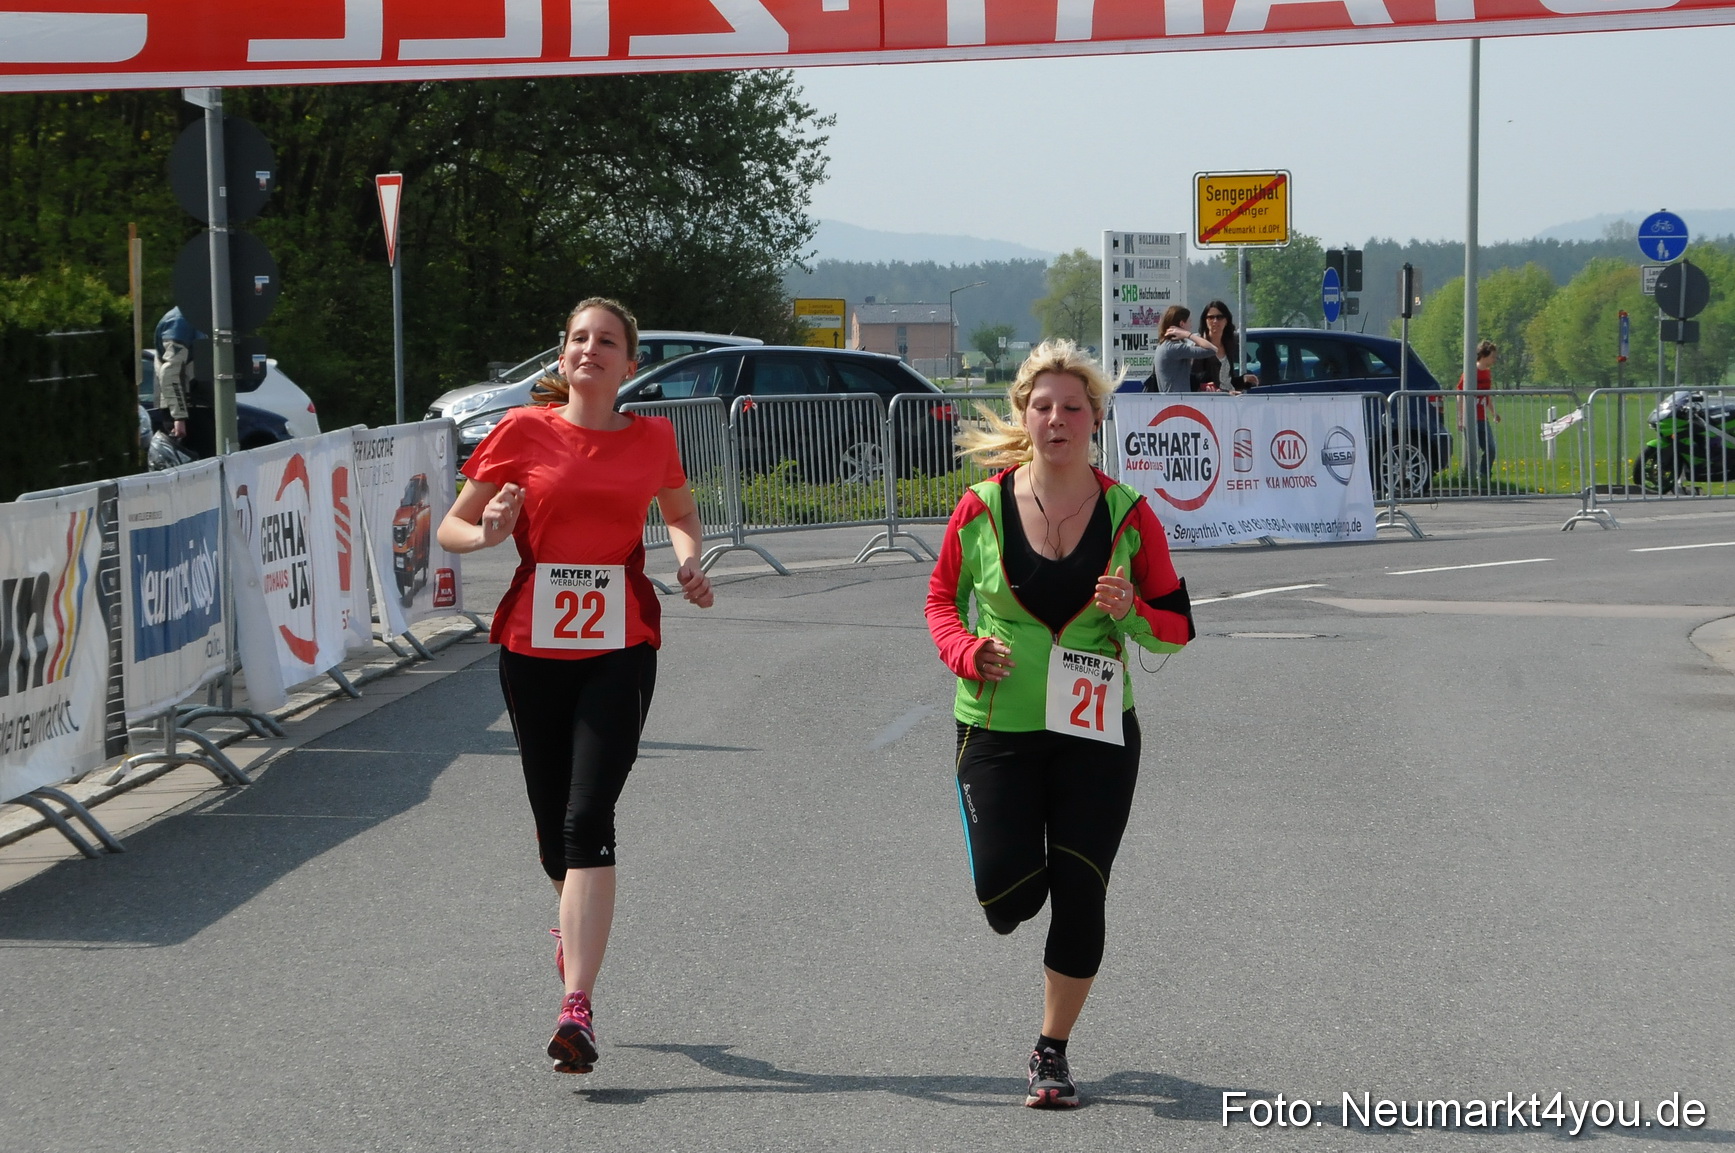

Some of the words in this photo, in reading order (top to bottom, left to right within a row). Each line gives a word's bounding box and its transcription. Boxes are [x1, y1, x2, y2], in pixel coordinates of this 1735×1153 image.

[1206, 184, 1279, 205] Sengenthal
[1216, 208, 1232, 216] am
[1237, 206, 1269, 218] Anger
[1224, 226, 1256, 234] Neumarkt
[1122, 284, 1138, 302] SHB
[1121, 333, 1148, 350] THULE
[1125, 431, 1200, 456] GERHART
[1277, 440, 1301, 460] KIA
[1163, 457, 1211, 481] JÄNIG
[1227, 479, 1259, 491] SEAT
[1265, 476, 1280, 489] KIA
[1282, 475, 1317, 489] MOTORS
[1174, 522, 1220, 543] Sengenthal
[550, 568, 592, 579] MEYER
[550, 579, 592, 587] WERBUNG
[554, 590, 605, 639] 22
[1063, 652, 1101, 669] MEYER
[1063, 662, 1100, 677] WERBUNG
[1070, 677, 1107, 732] 21
[14, 694, 80, 751] neumarkt
